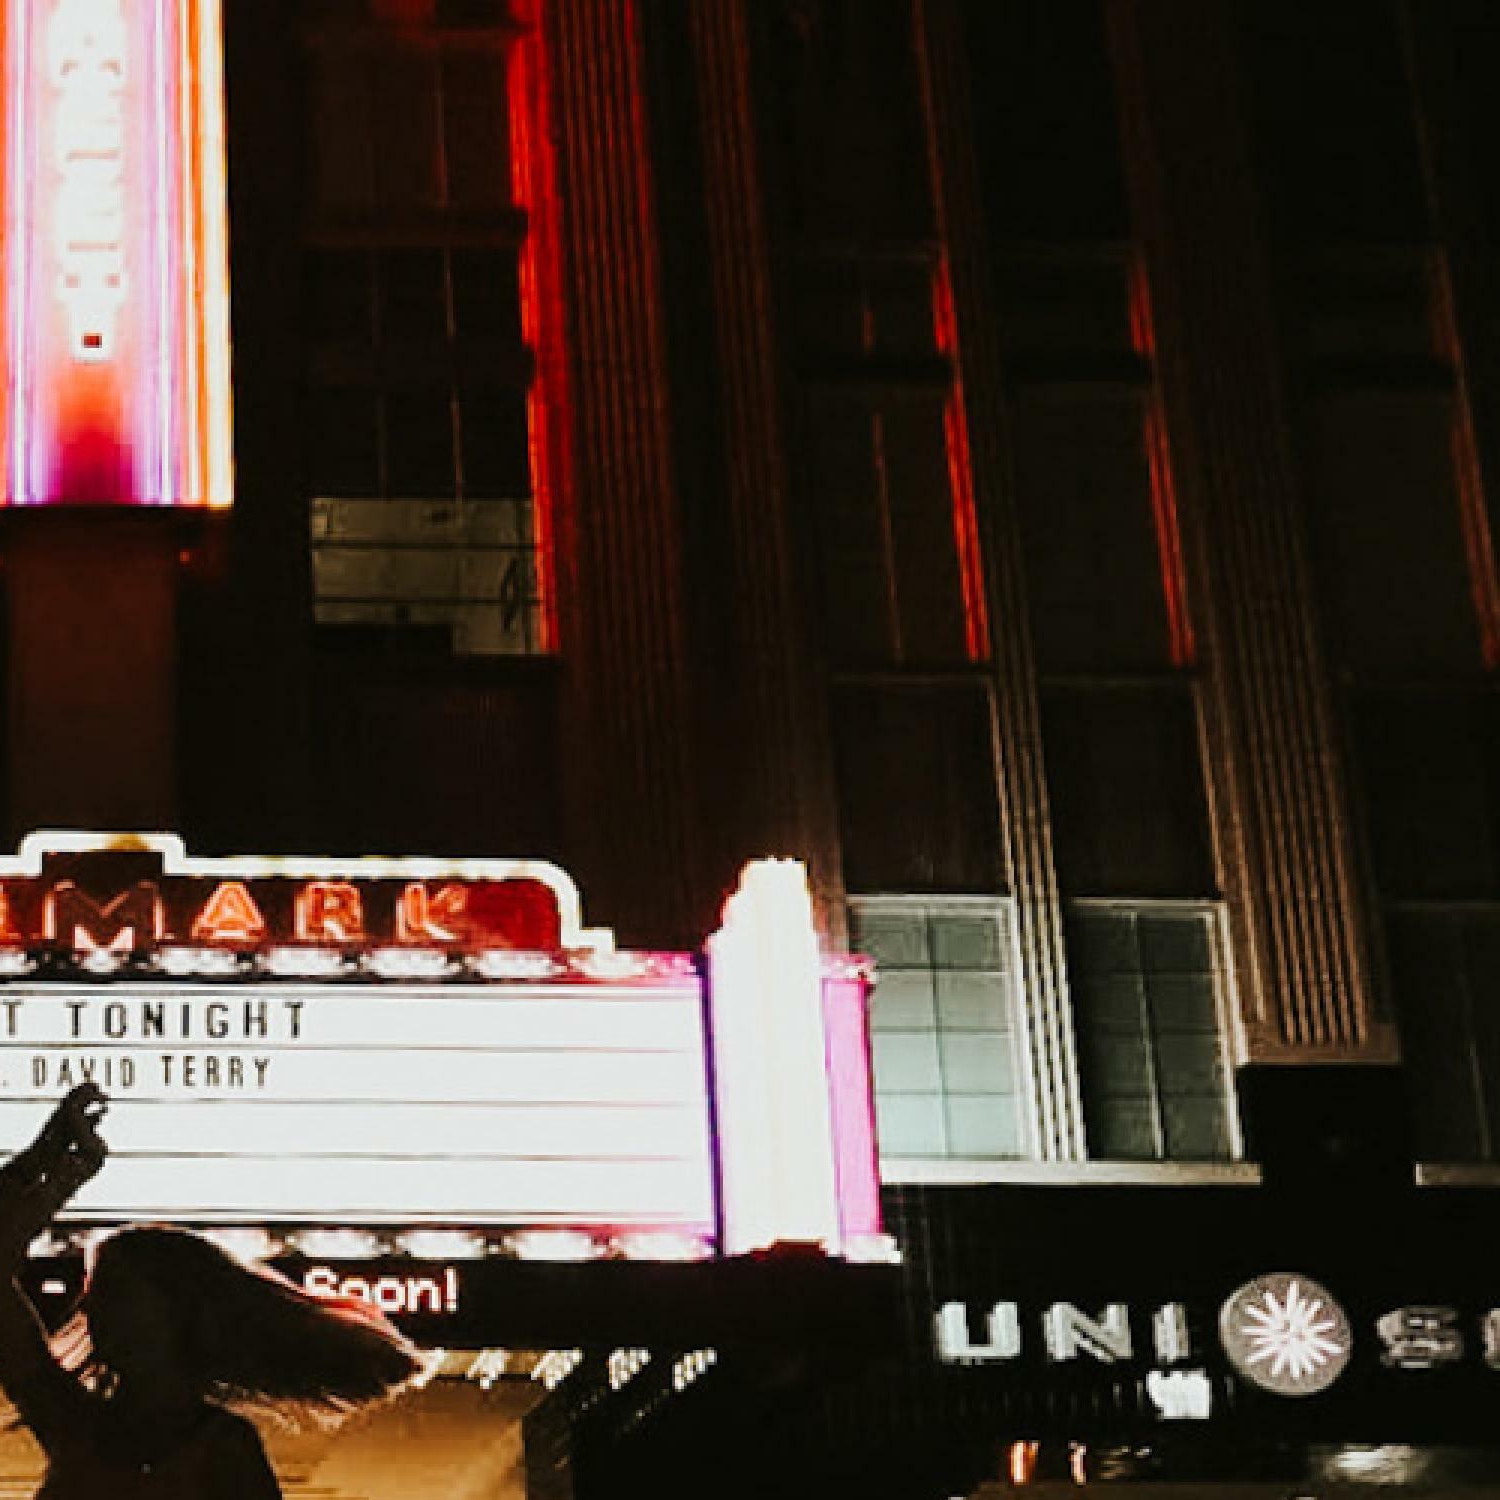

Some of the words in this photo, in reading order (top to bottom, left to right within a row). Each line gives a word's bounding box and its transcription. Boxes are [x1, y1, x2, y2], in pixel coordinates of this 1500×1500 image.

[65, 1001, 305, 1038] TONIGHT
[31, 1056, 136, 1088] DAVID
[160, 1054, 271, 1088] TERRY
[934, 1302, 1190, 1364] UNI
